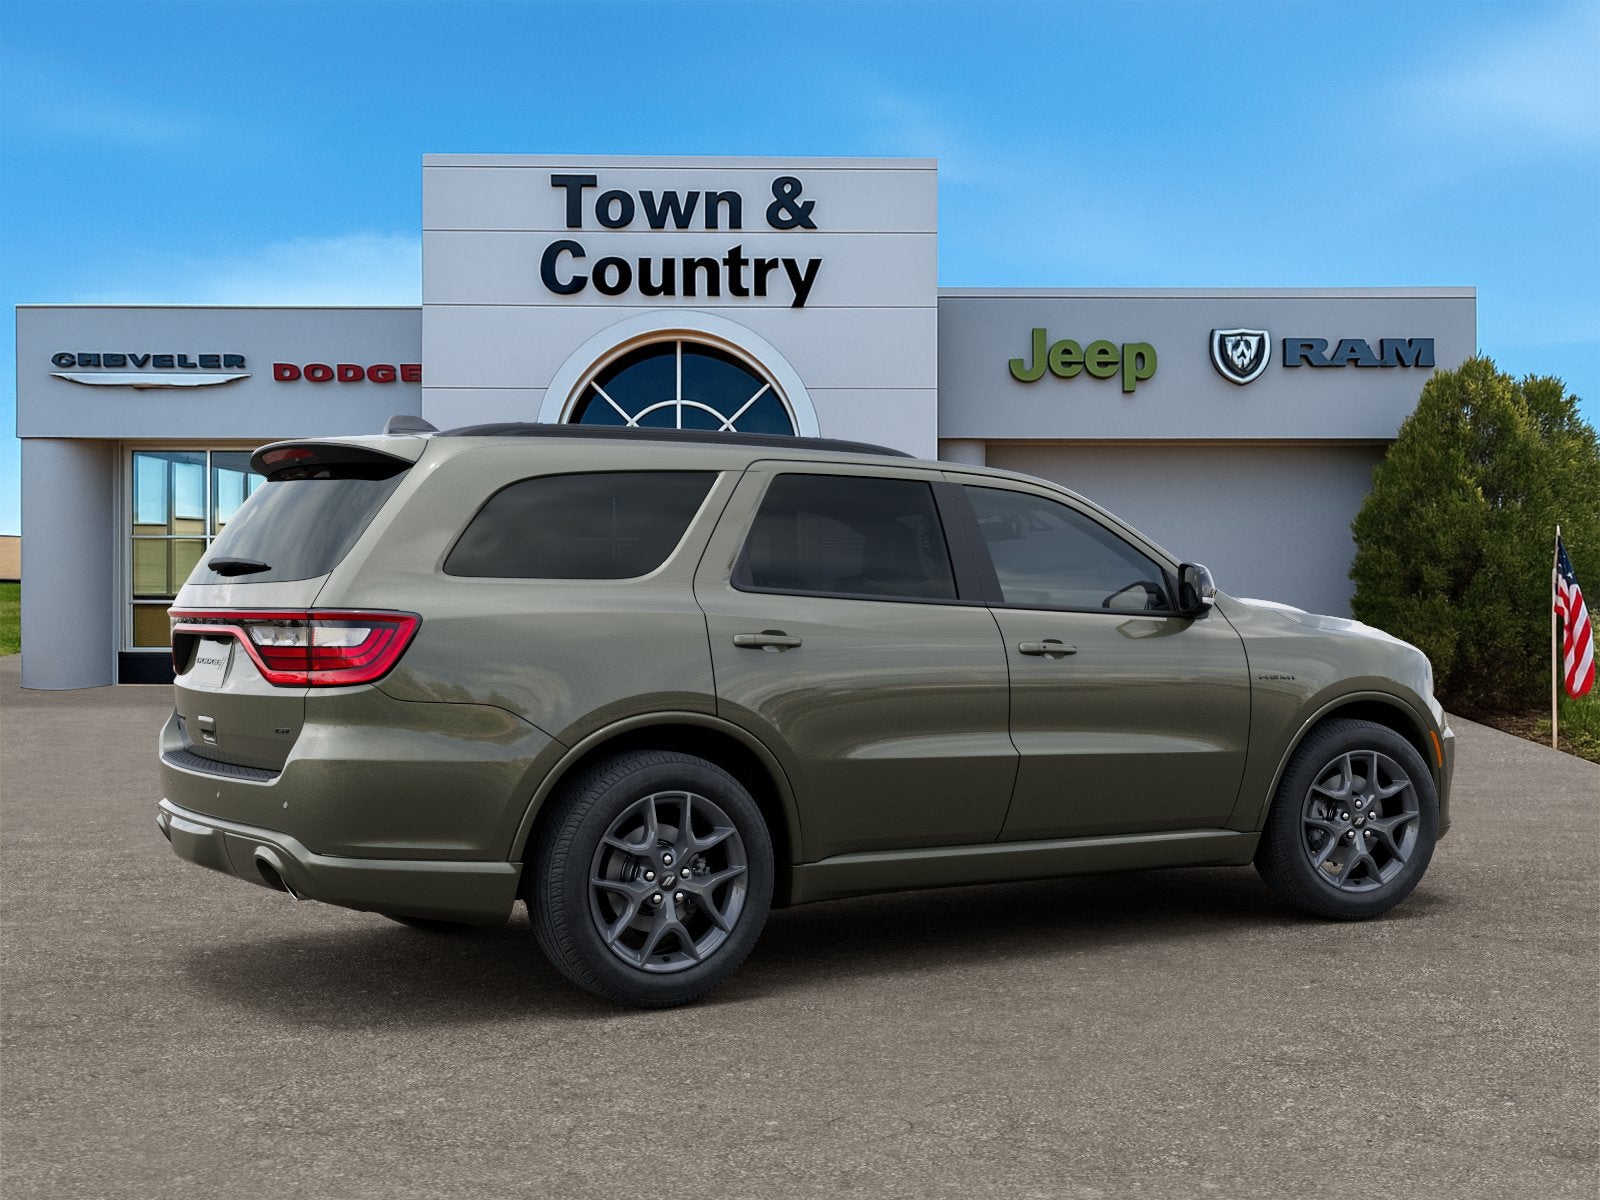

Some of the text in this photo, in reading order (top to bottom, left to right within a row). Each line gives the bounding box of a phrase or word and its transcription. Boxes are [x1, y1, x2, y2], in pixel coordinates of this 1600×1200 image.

[550, 174, 818, 229] Town &
[540, 239, 822, 308] Country
[273, 363, 422, 383] DODGE
[1009, 328, 1157, 392] Jeep
[1282, 337, 1435, 367] RAM
